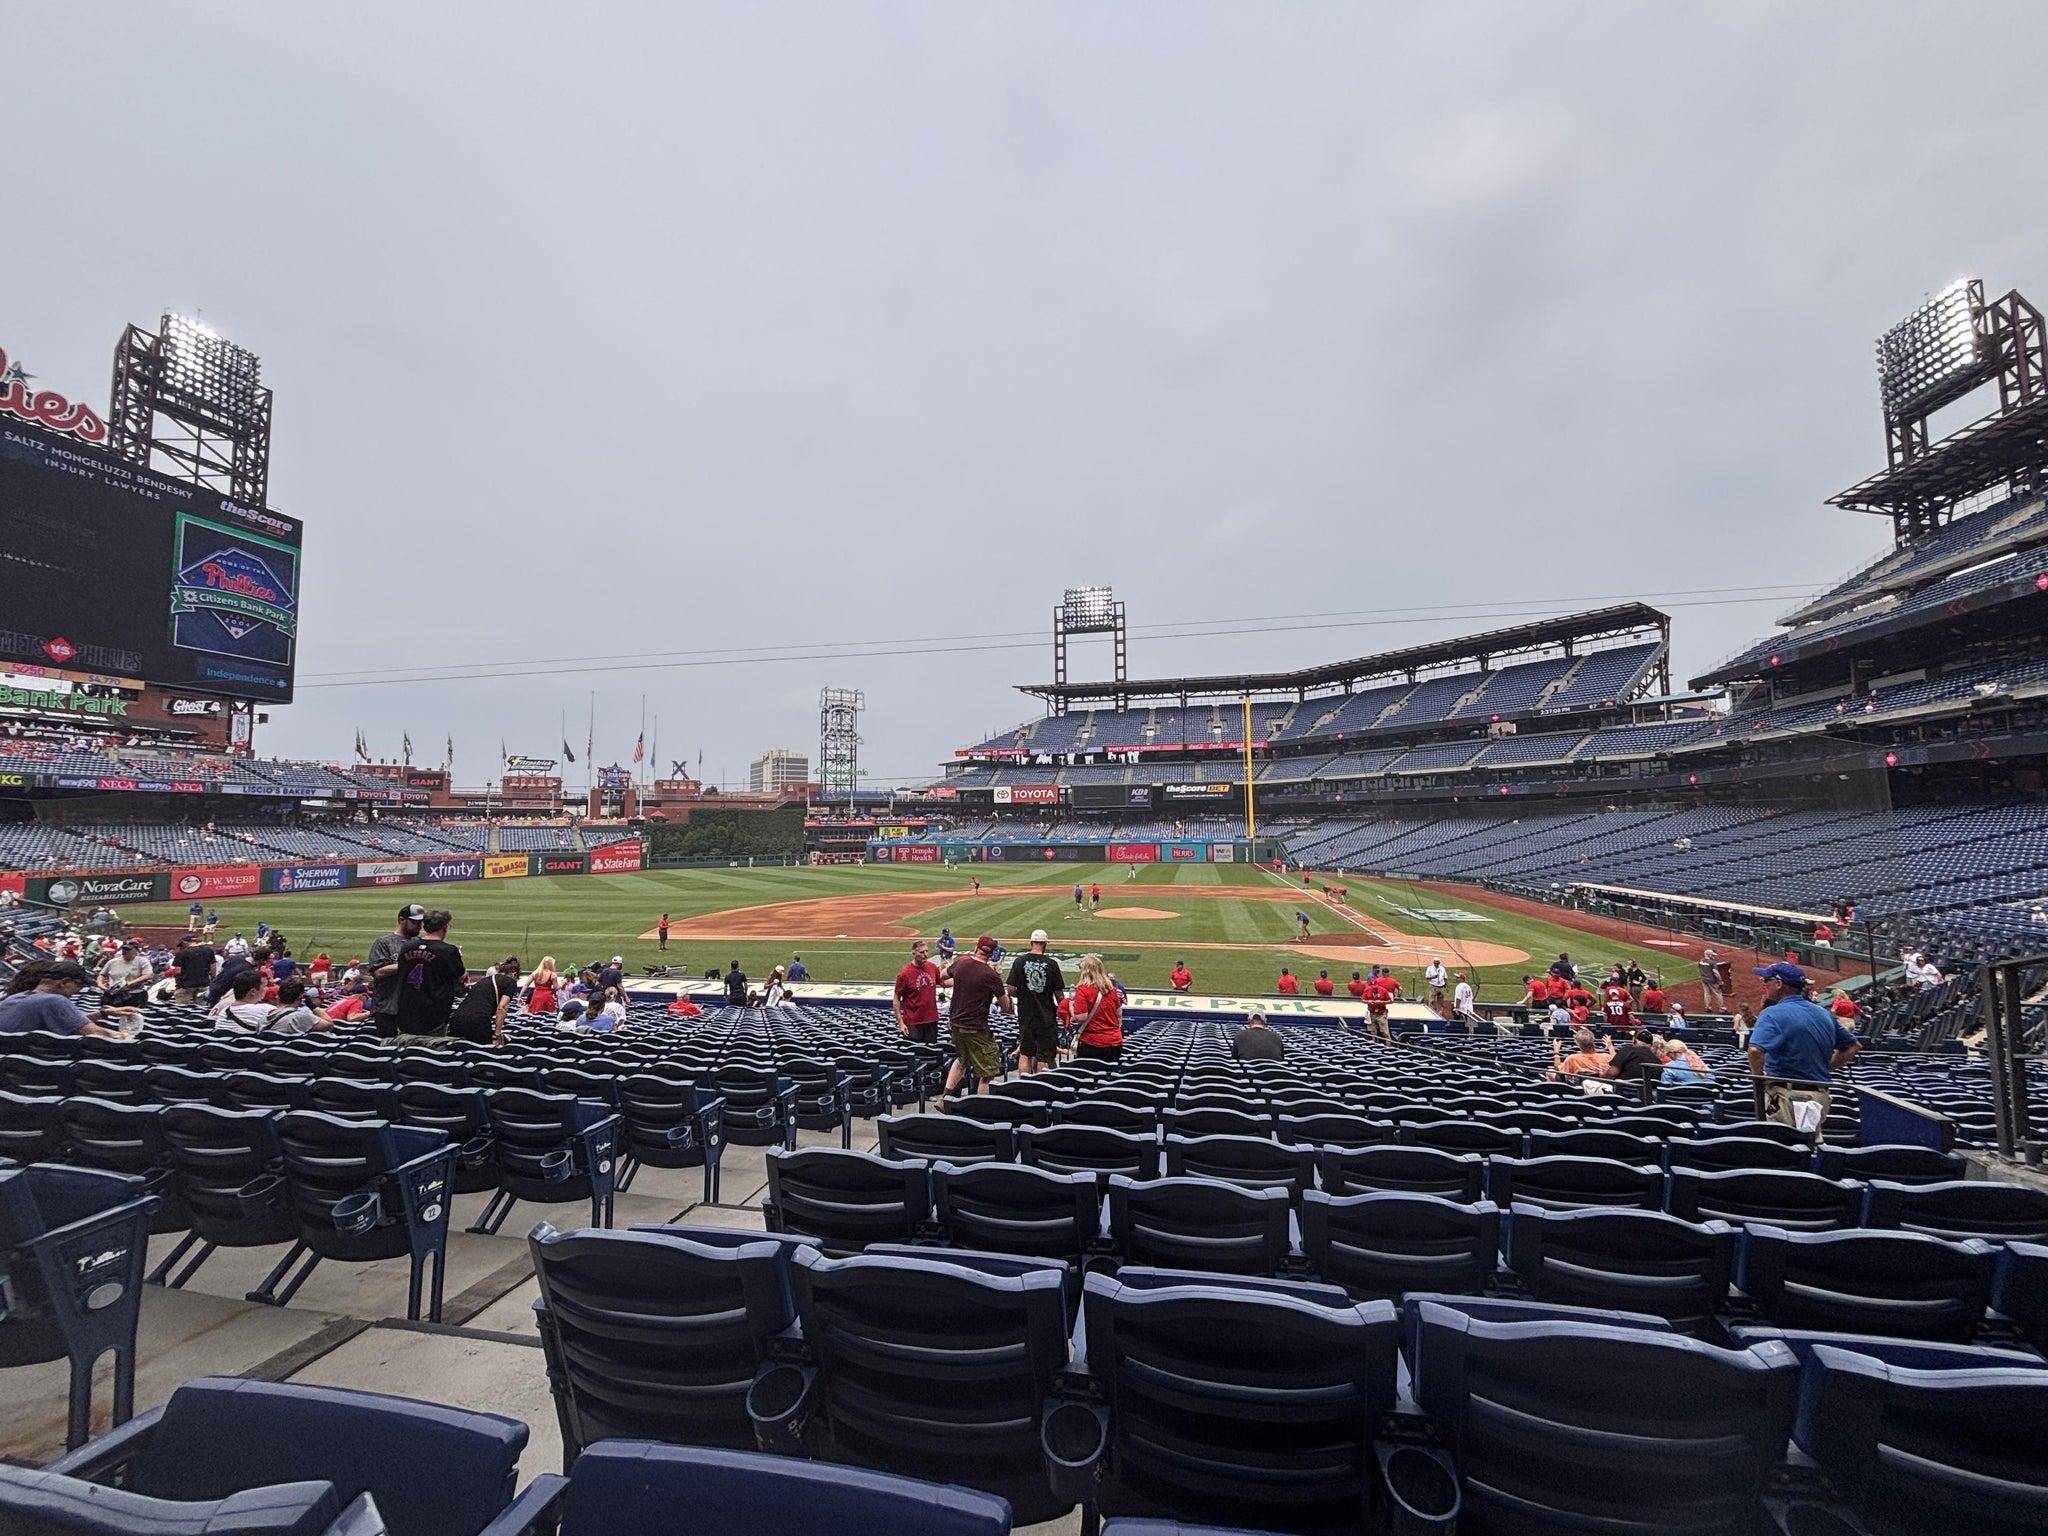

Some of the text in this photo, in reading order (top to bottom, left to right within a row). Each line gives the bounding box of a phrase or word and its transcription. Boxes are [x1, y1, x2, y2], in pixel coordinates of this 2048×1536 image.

[0, 352, 106, 441] ies
[4, 431, 193, 500] SALTZ MONGELUZZI BENDESKY
[45, 458, 160, 500] INJURY LAWYERS
[220, 500, 293, 532] theScore
[202, 563, 276, 601] Phillies
[199, 593, 287, 622] Citizens Bank Park
[207, 667, 276, 686] Independence
[0, 684, 128, 716] Bank Park
[172, 699, 213, 713] GHOST
[174, 783, 203, 792] NECA
[283, 788, 316, 796] BAKERY
[1014, 789, 1054, 799] TOYOTA
[1166, 784, 1207, 794] theScore
[911, 847, 934, 856] Temple
[429, 861, 475, 879] xfinity
[545, 861, 583, 870] GIANT
[295, 868, 339, 878] SHERWIN
[80, 879, 152, 893] NovaCare
[407, 963, 424, 989] 4
[1134, 998, 1325, 1012] nk Park
[1610, 1006, 1623, 1015] 10
